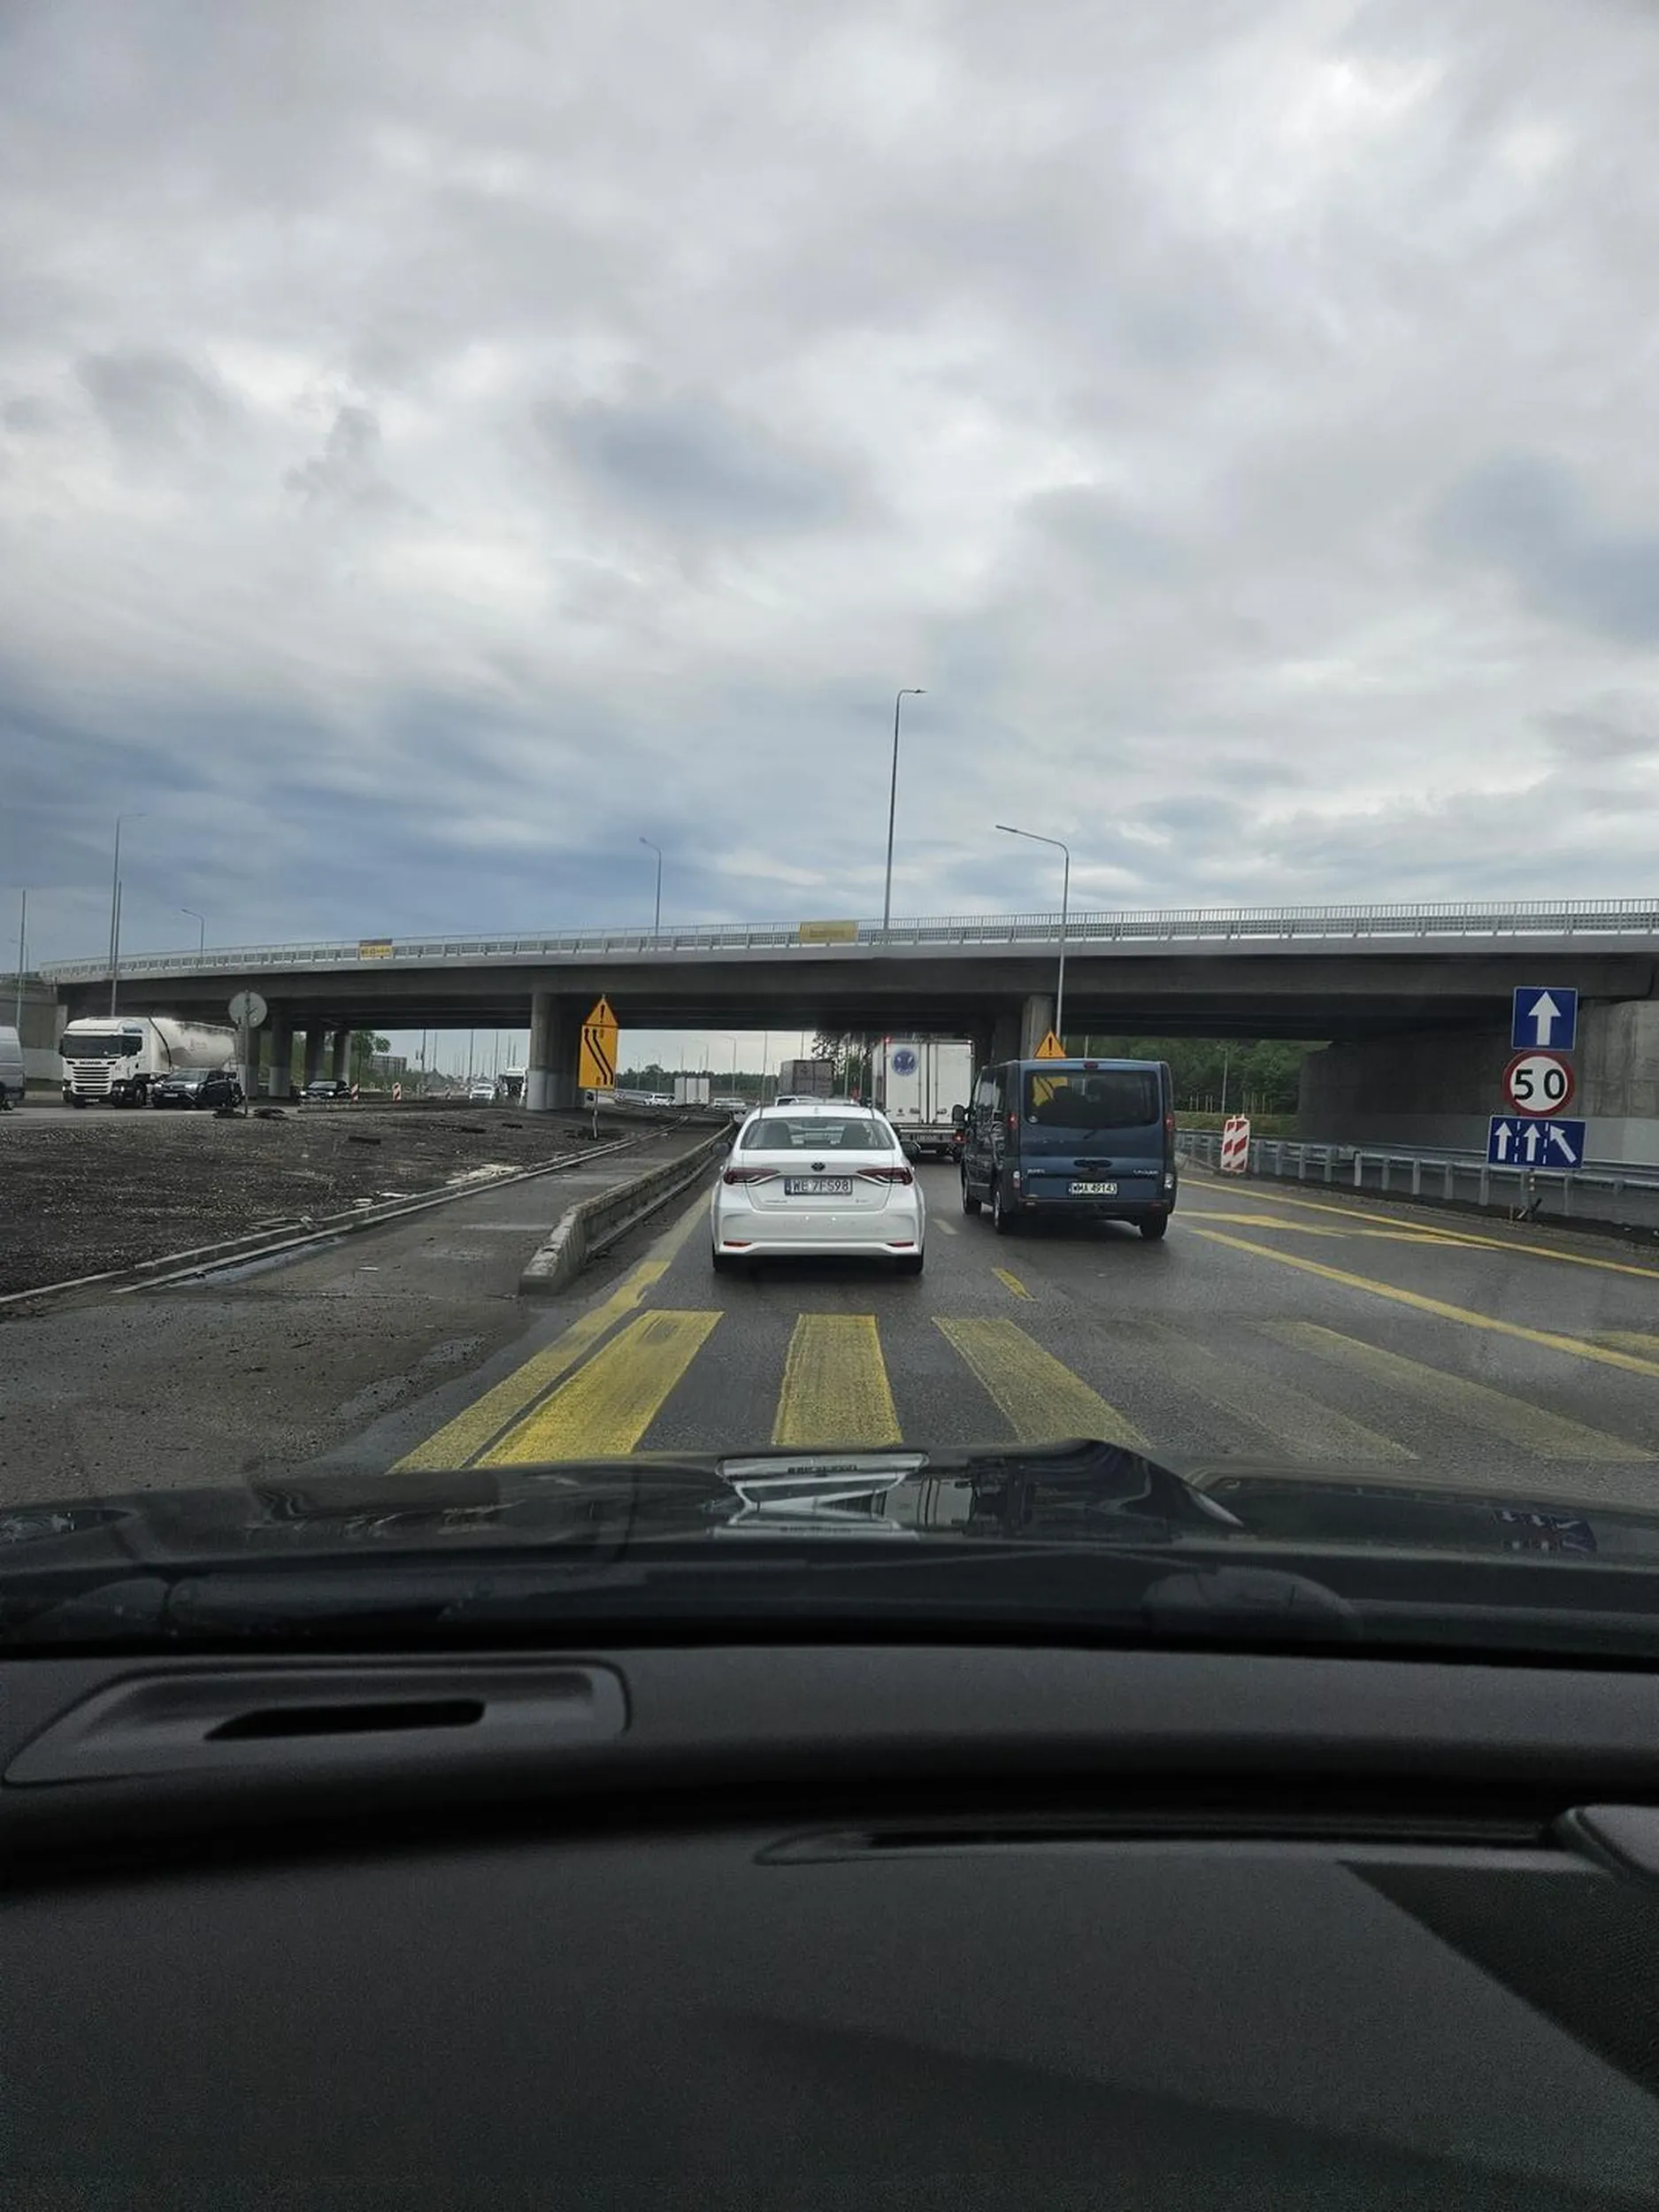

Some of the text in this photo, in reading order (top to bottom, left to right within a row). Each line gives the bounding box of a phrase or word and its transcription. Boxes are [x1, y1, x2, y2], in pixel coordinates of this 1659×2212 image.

[1513, 1068, 1566, 1100] 50
[793, 1178, 849, 1191] WE 7FS98
